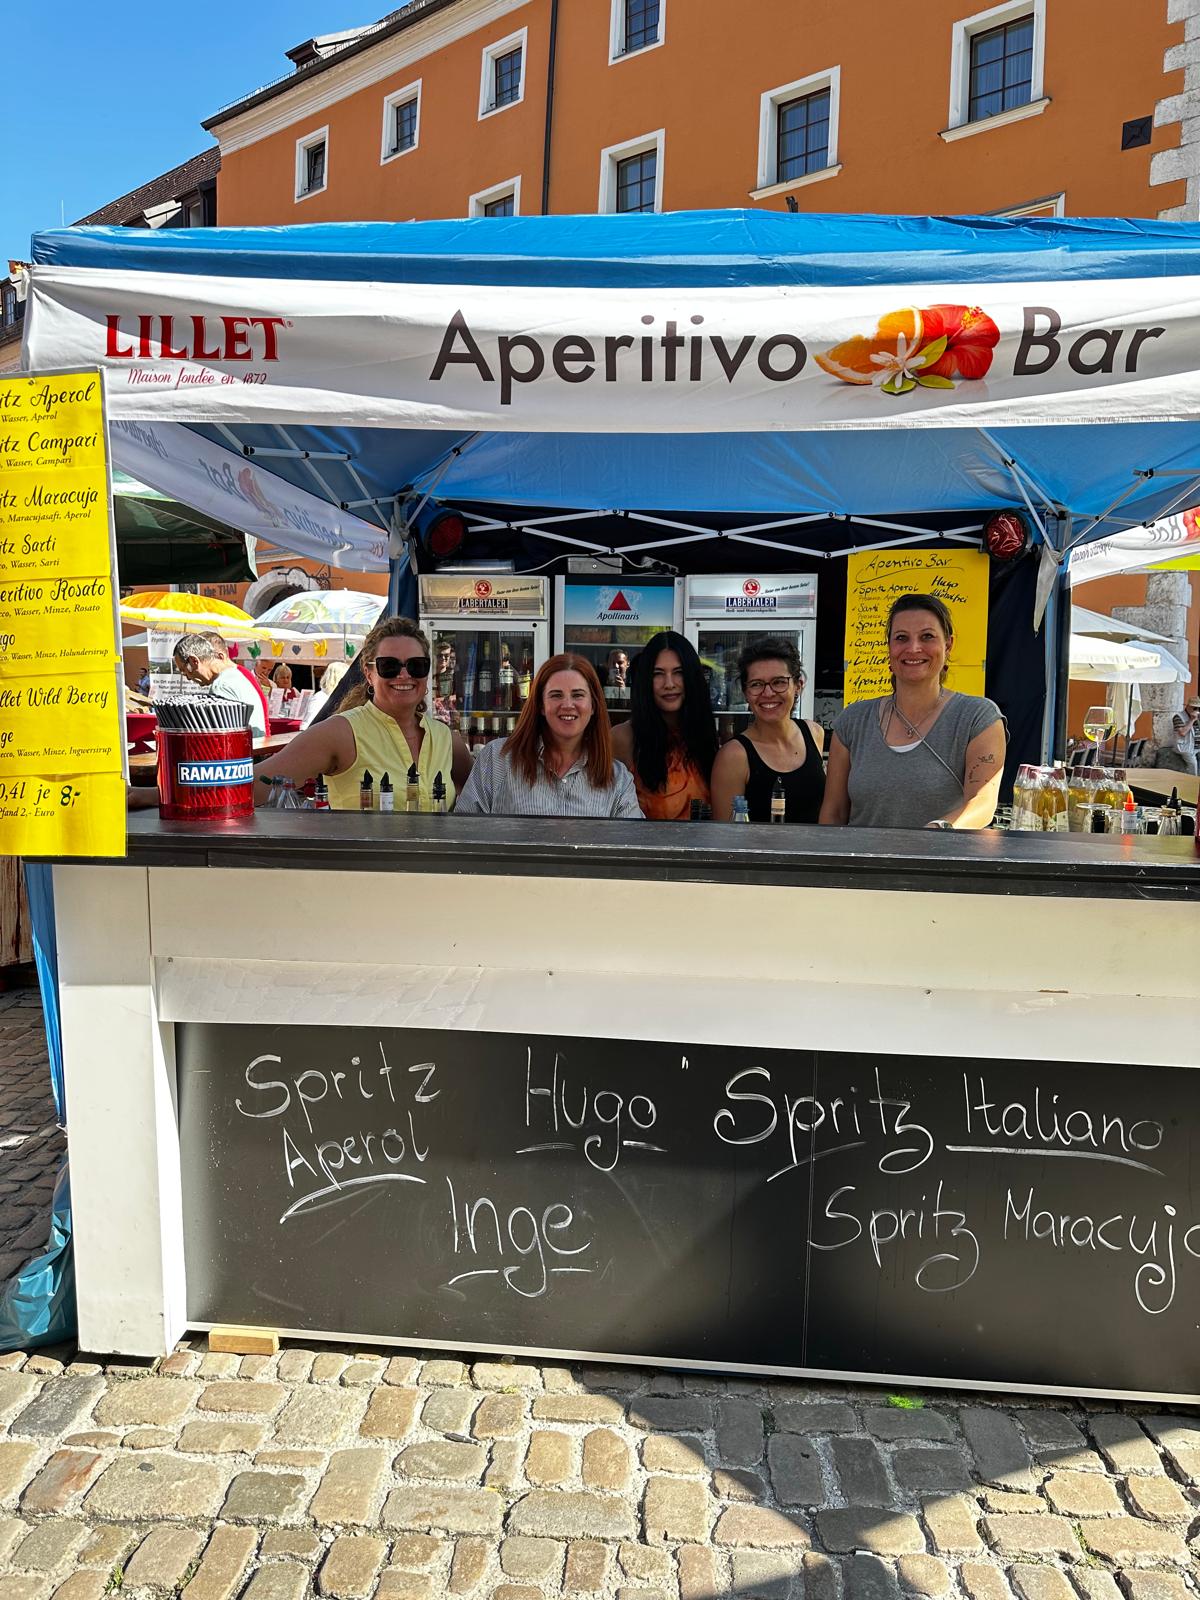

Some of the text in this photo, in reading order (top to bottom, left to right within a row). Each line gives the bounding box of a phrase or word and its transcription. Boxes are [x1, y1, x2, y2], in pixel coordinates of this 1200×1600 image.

[429, 306, 1166, 405] Aperitivo Bar
[127, 367, 267, 390] Maison fondée en 1872
[30, 381, 96, 412] Aperol
[1, 411, 57, 423] Wasser, Aperol
[28, 431, 97, 456] Campari
[6, 458, 32, 467] Wasser,
[36, 456, 72, 467] Campari
[24, 485, 98, 508] Maracuja
[64, 510, 90, 521] Aperol
[21, 534, 56, 554] Sarti
[11, 560, 37, 568] Wasser,
[40, 558, 59, 567] Sarti
[925, 553, 952, 567] Bar
[50, 578, 105, 600] Rosato
[888, 583, 919, 594] Aperol
[931, 575, 959, 592] Hugo
[14, 607, 40, 616] Wasser,
[43, 606, 70, 614] Minze,
[74, 604, 100, 612] Rosato
[460, 599, 507, 608] LABERTALER
[727, 597, 776, 607] LABERTALER
[597, 612, 639, 621] Apollinaris
[11, 652, 32, 660] Wasser,
[59, 648, 108, 657] Holundersirup
[27, 687, 62, 706] Wild
[67, 685, 108, 708] Berry
[17, 749, 40, 757] Wasser,
[69, 746, 111, 756] Ingwersirup
[33, 784, 50, 806] je
[34, 808, 55, 817] Euro
[236, 1041, 440, 1133] Spritz
[527, 1046, 657, 1171] Hugo
[714, 1067, 1162, 1174] Spritz Italiano
[283, 1110, 428, 1190] Aperol
[447, 1176, 590, 1297] Inge
[806, 1181, 979, 1292] Spritz
